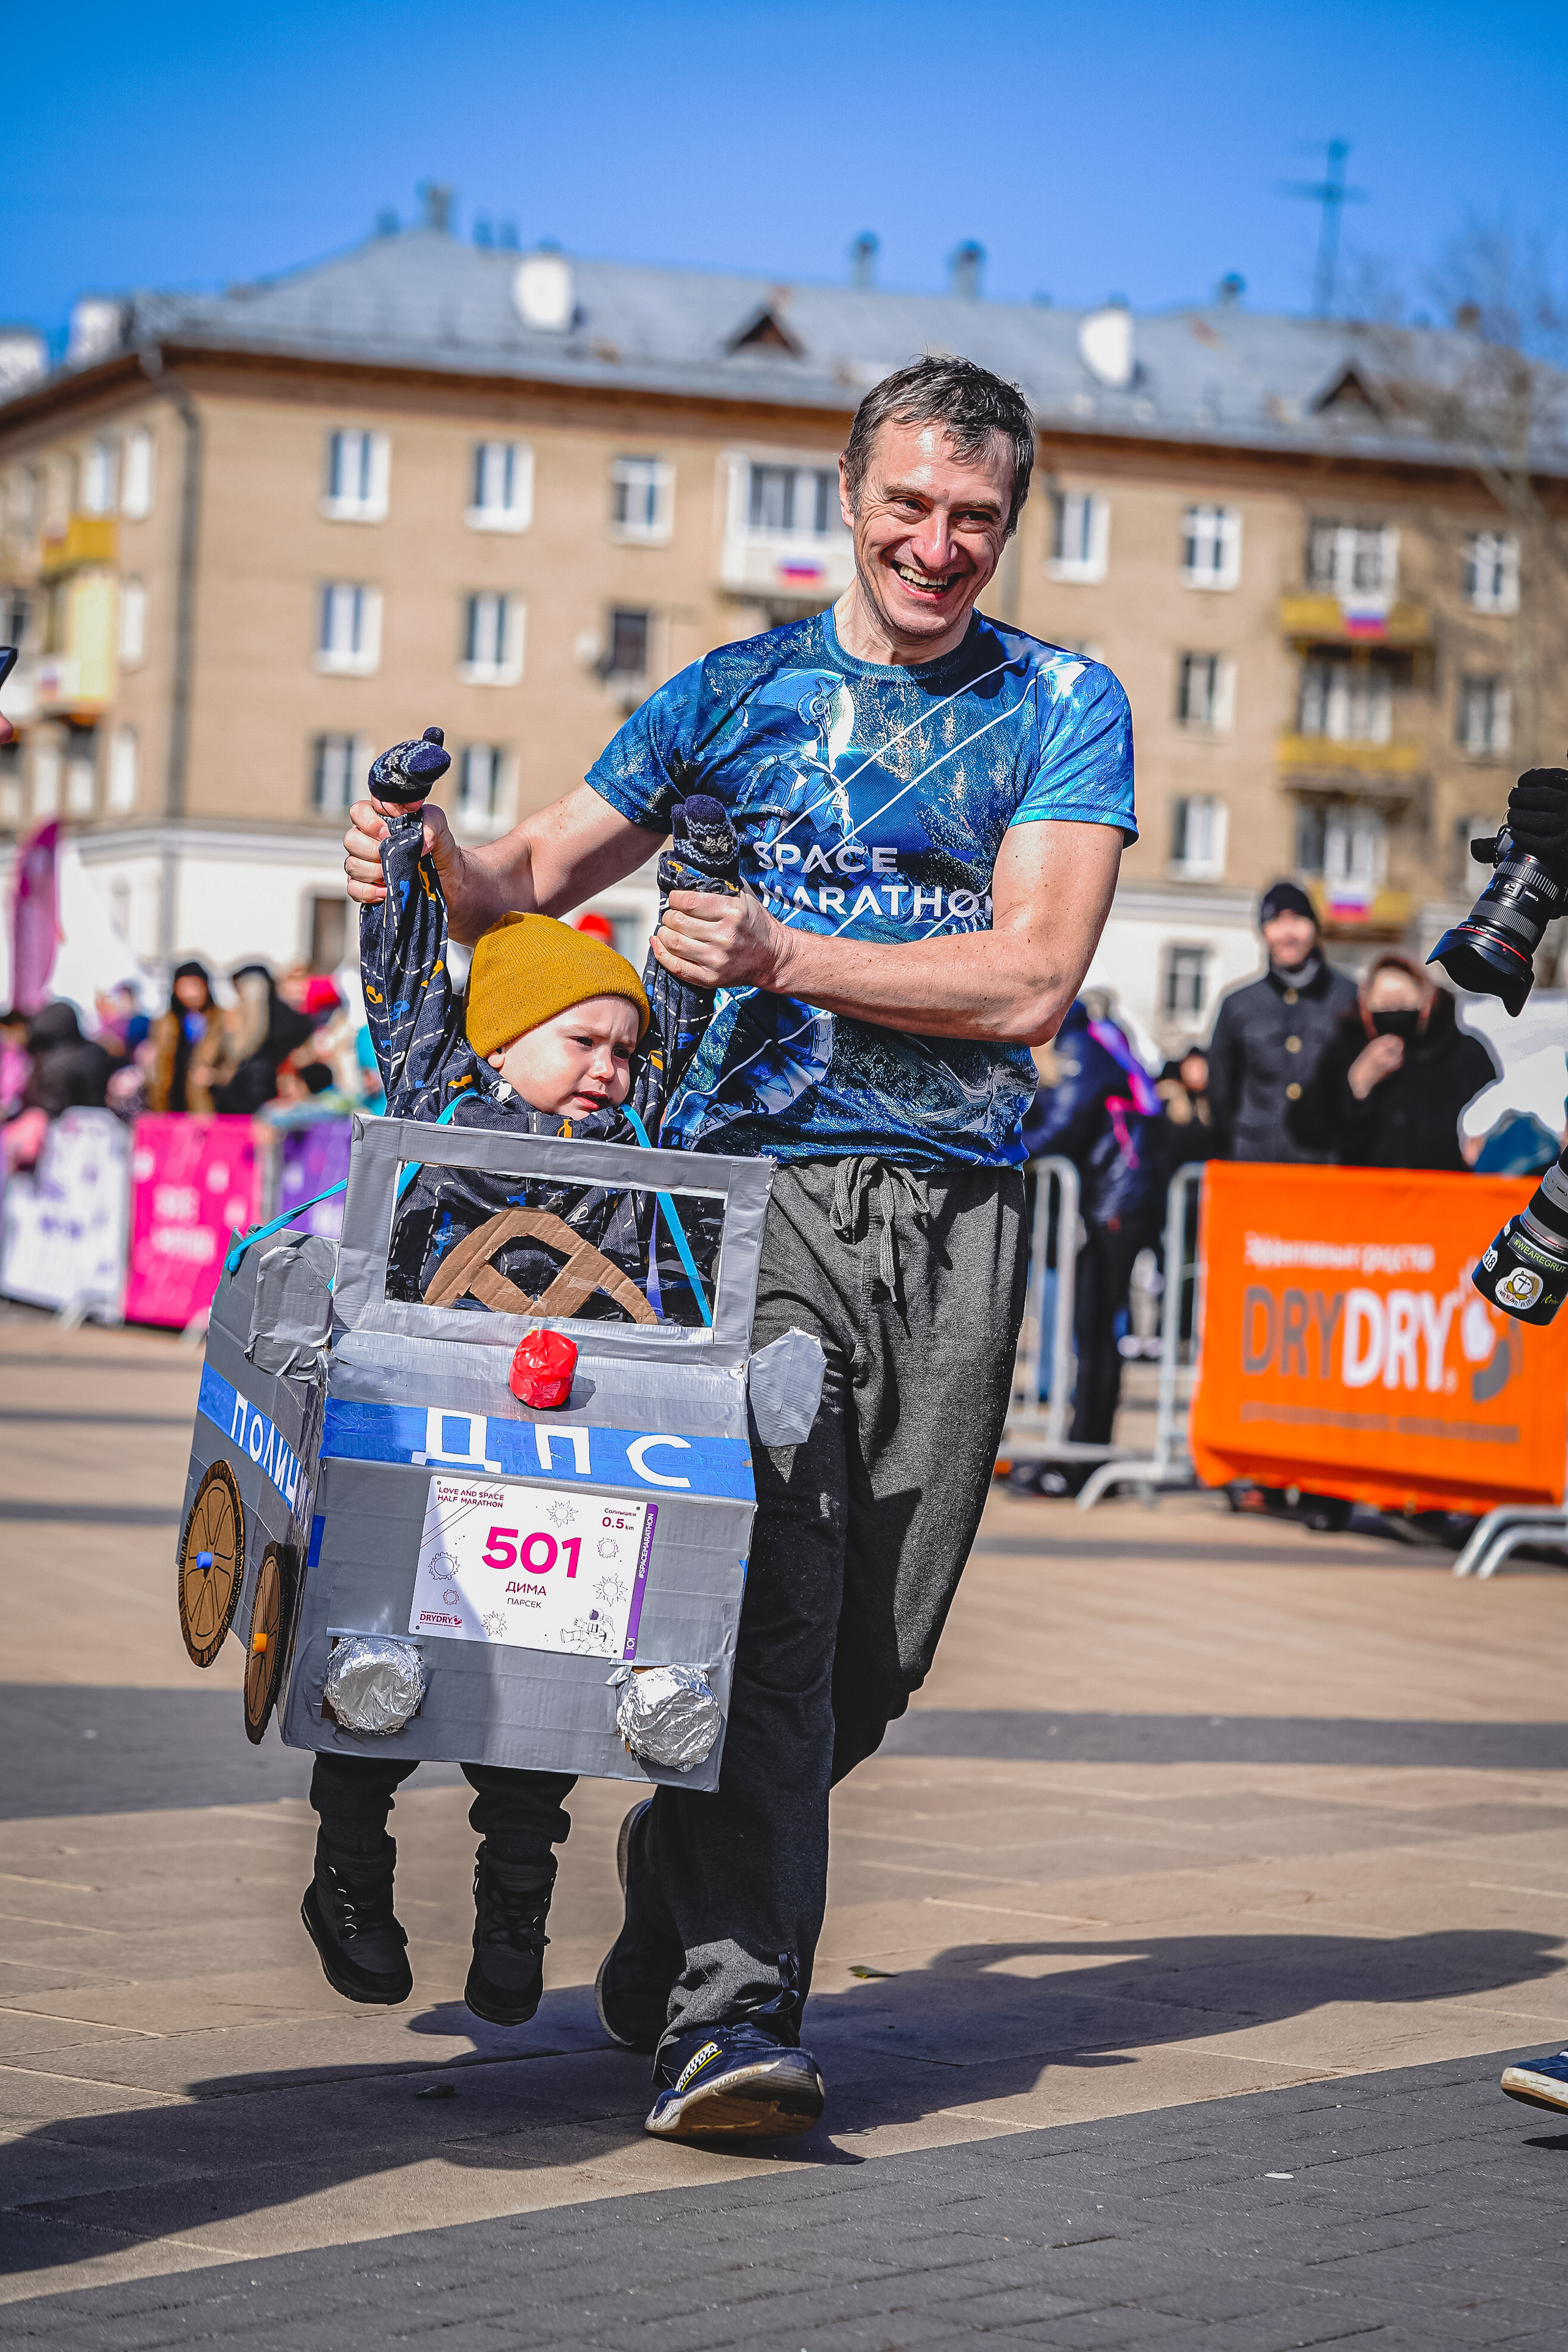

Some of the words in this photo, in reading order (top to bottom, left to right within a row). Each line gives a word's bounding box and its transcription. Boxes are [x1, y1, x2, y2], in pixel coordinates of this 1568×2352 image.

[753, 842, 897, 873] SPACE
[411, 1407, 692, 1487] ДПС
[461, 1498, 503, 1508] MARATHON
[605, 1508, 636, 1517] Солнышки
[602, 1517, 624, 1529] 0.5
[481, 1526, 581, 1578] 501
[638, 1513, 655, 1579] #SPACEMARATHON
[505, 1581, 546, 1596] ДИМА
[507, 1597, 542, 1608] ПАРСЕК
